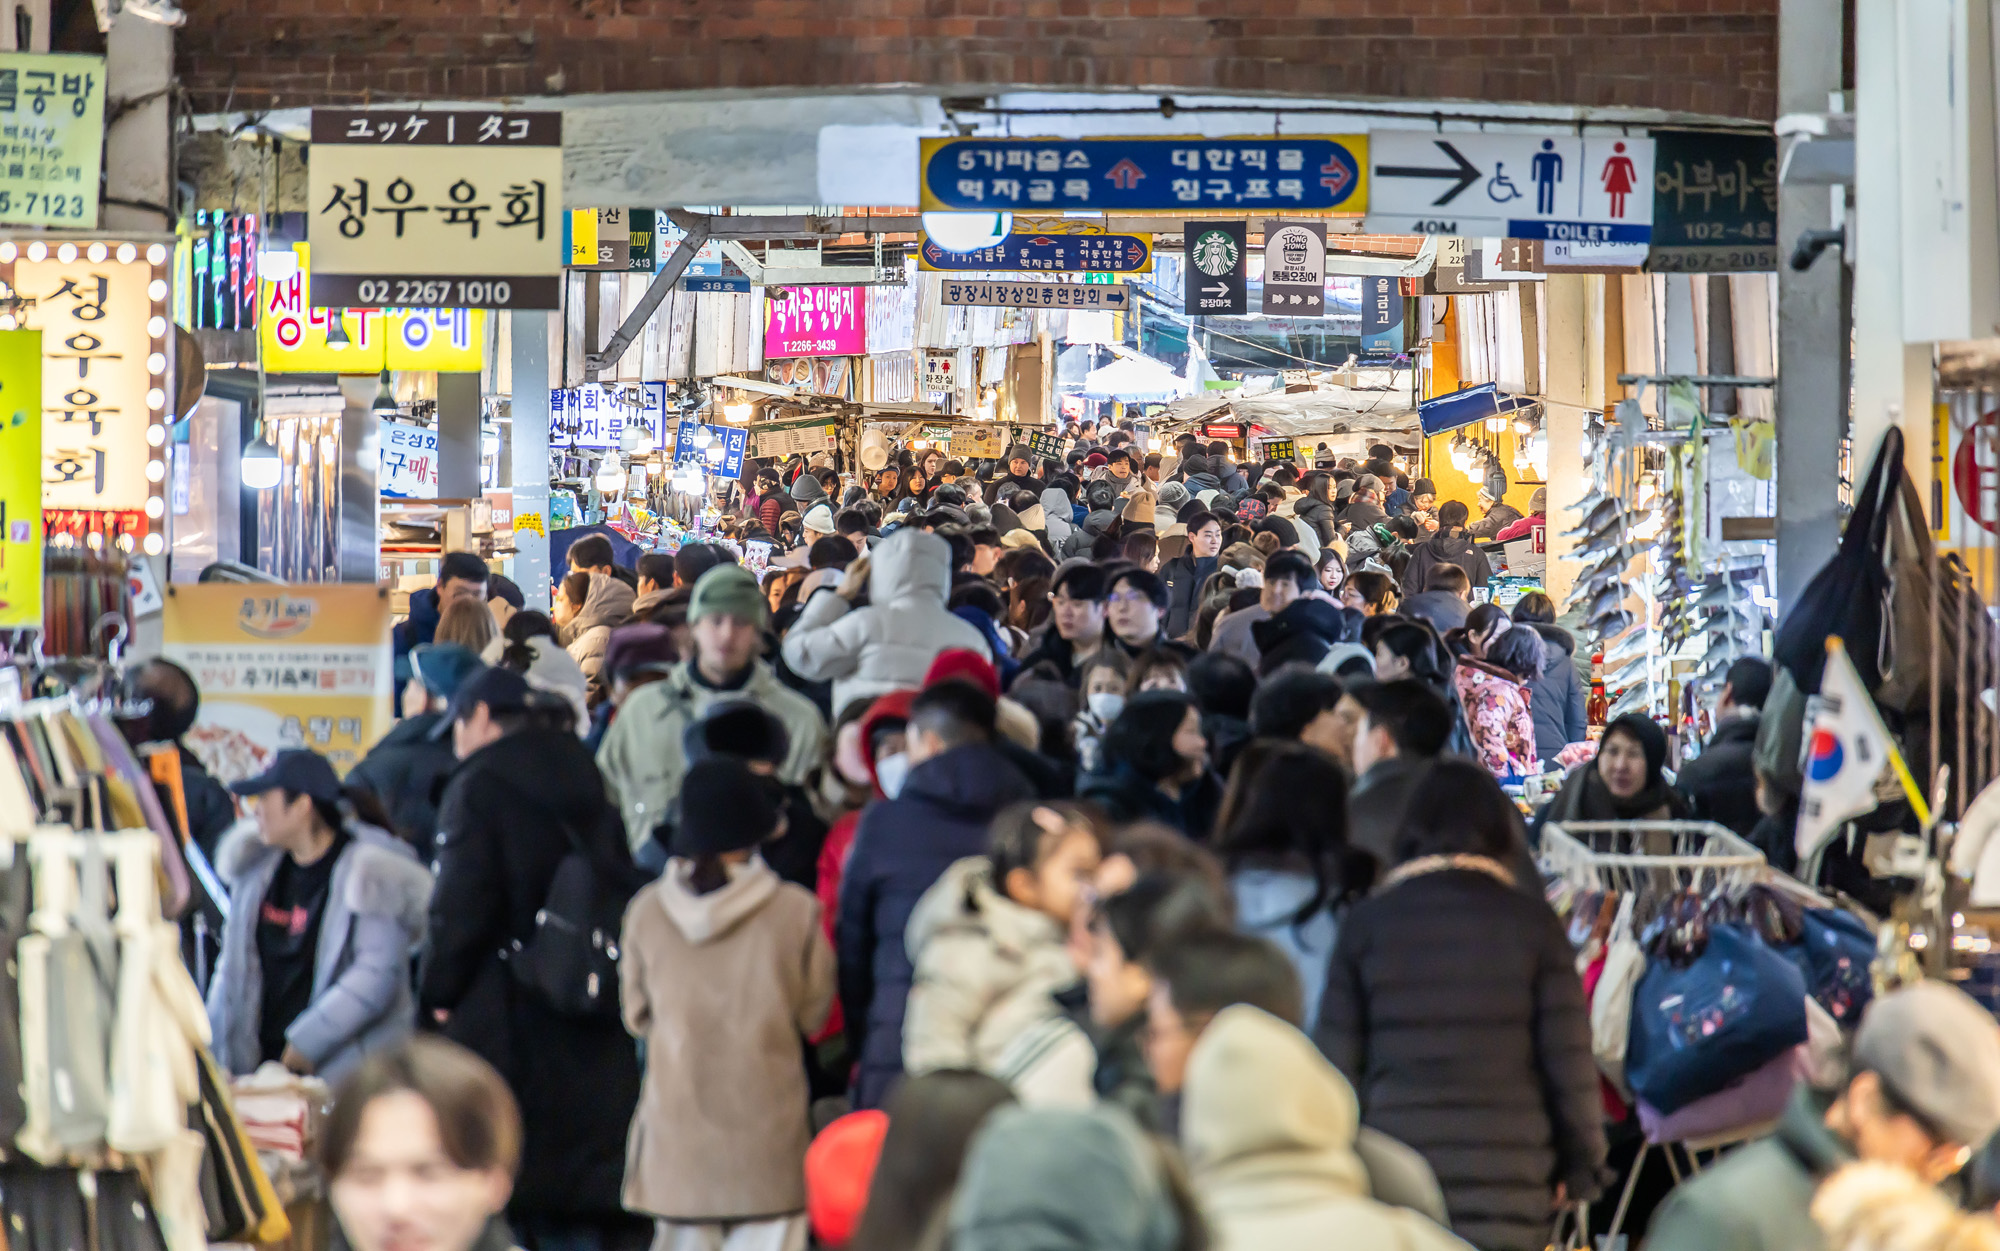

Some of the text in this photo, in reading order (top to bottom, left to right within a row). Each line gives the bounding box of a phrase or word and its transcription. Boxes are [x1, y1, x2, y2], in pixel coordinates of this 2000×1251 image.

[346, 114, 530, 143] ユッケ タコ
[957, 149, 1305, 171] 5가파출소 대한직물
[956, 178, 1092, 201] 먹자골목
[1655, 157, 1777, 213] 어부마을
[320, 176, 547, 241] 성우육회
[1282, 233, 1308, 245] TONG
[1413, 221, 1612, 241] 40M TOILET
[1020, 258, 1066, 269] 먹자골목
[1658, 252, 1777, 268] 2267-205
[1272, 270, 1318, 283] 통통오징어
[358, 279, 511, 305] 02 2267 1010
[702, 281, 736, 291] 38호
[949, 284, 1101, 305] 광장시장상인총연합회
[1199, 298, 1232, 308] 광장마켓
[782, 339, 837, 352] T.2266-3439
[43, 273, 123, 496] 성우육회
[925, 374, 954, 385] 화장실
[1037, 442, 1063, 457] 빈대떡
[1039, 435, 1065, 449] 순희네
[726, 434, 743, 474] 전복
